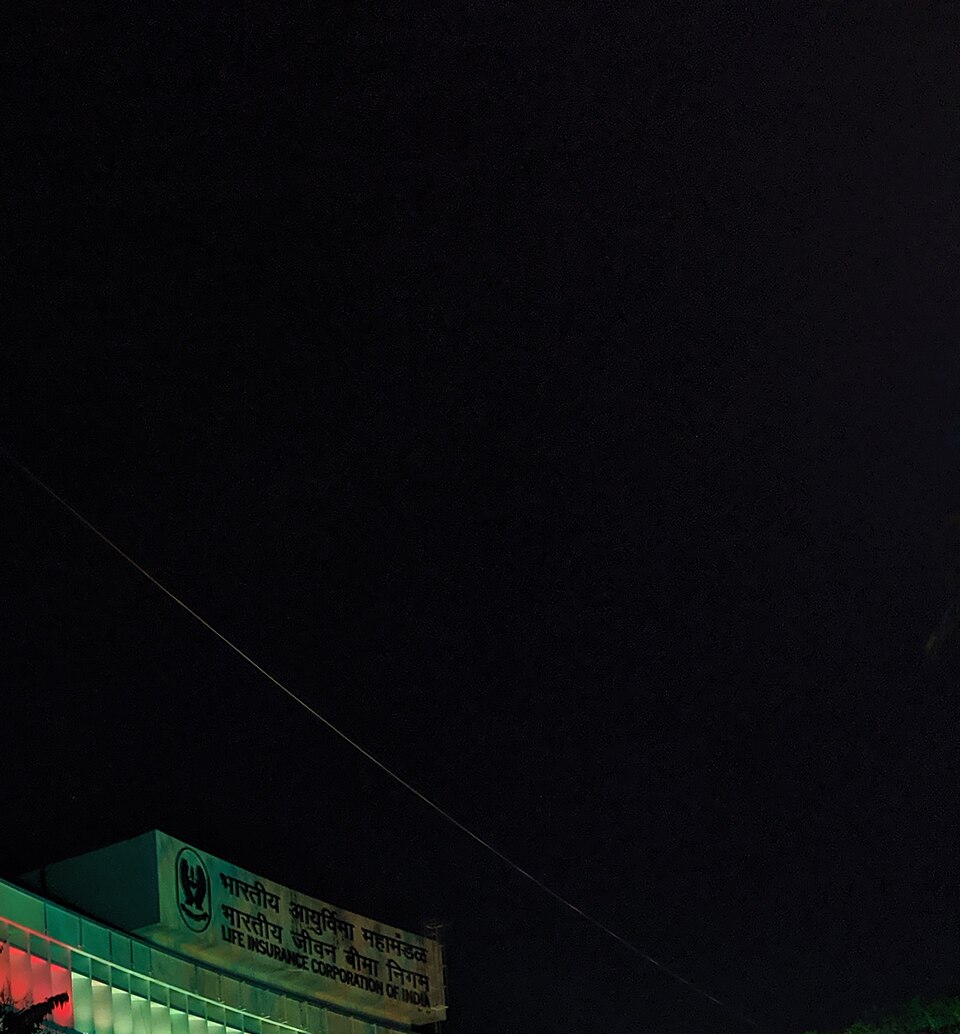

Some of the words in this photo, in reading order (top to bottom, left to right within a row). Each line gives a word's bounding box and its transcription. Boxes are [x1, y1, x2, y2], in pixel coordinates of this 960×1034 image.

[220, 873, 281, 913] भारतीय
[289, 901, 355, 940] आयुर्विमा
[361, 928, 429, 963] महामंडळ
[222, 904, 284, 944] भारतीय
[291, 929, 337, 964] जीवन
[344, 945, 380, 978] बीमा
[386, 959, 430, 993] निगम
[222, 925, 246, 948] LIFE
[248, 934, 310, 971] INSURANCE
[311, 959, 385, 996] CORPORATION
[386, 983, 400, 999] OF
[401, 986, 431, 1008] INDIA
